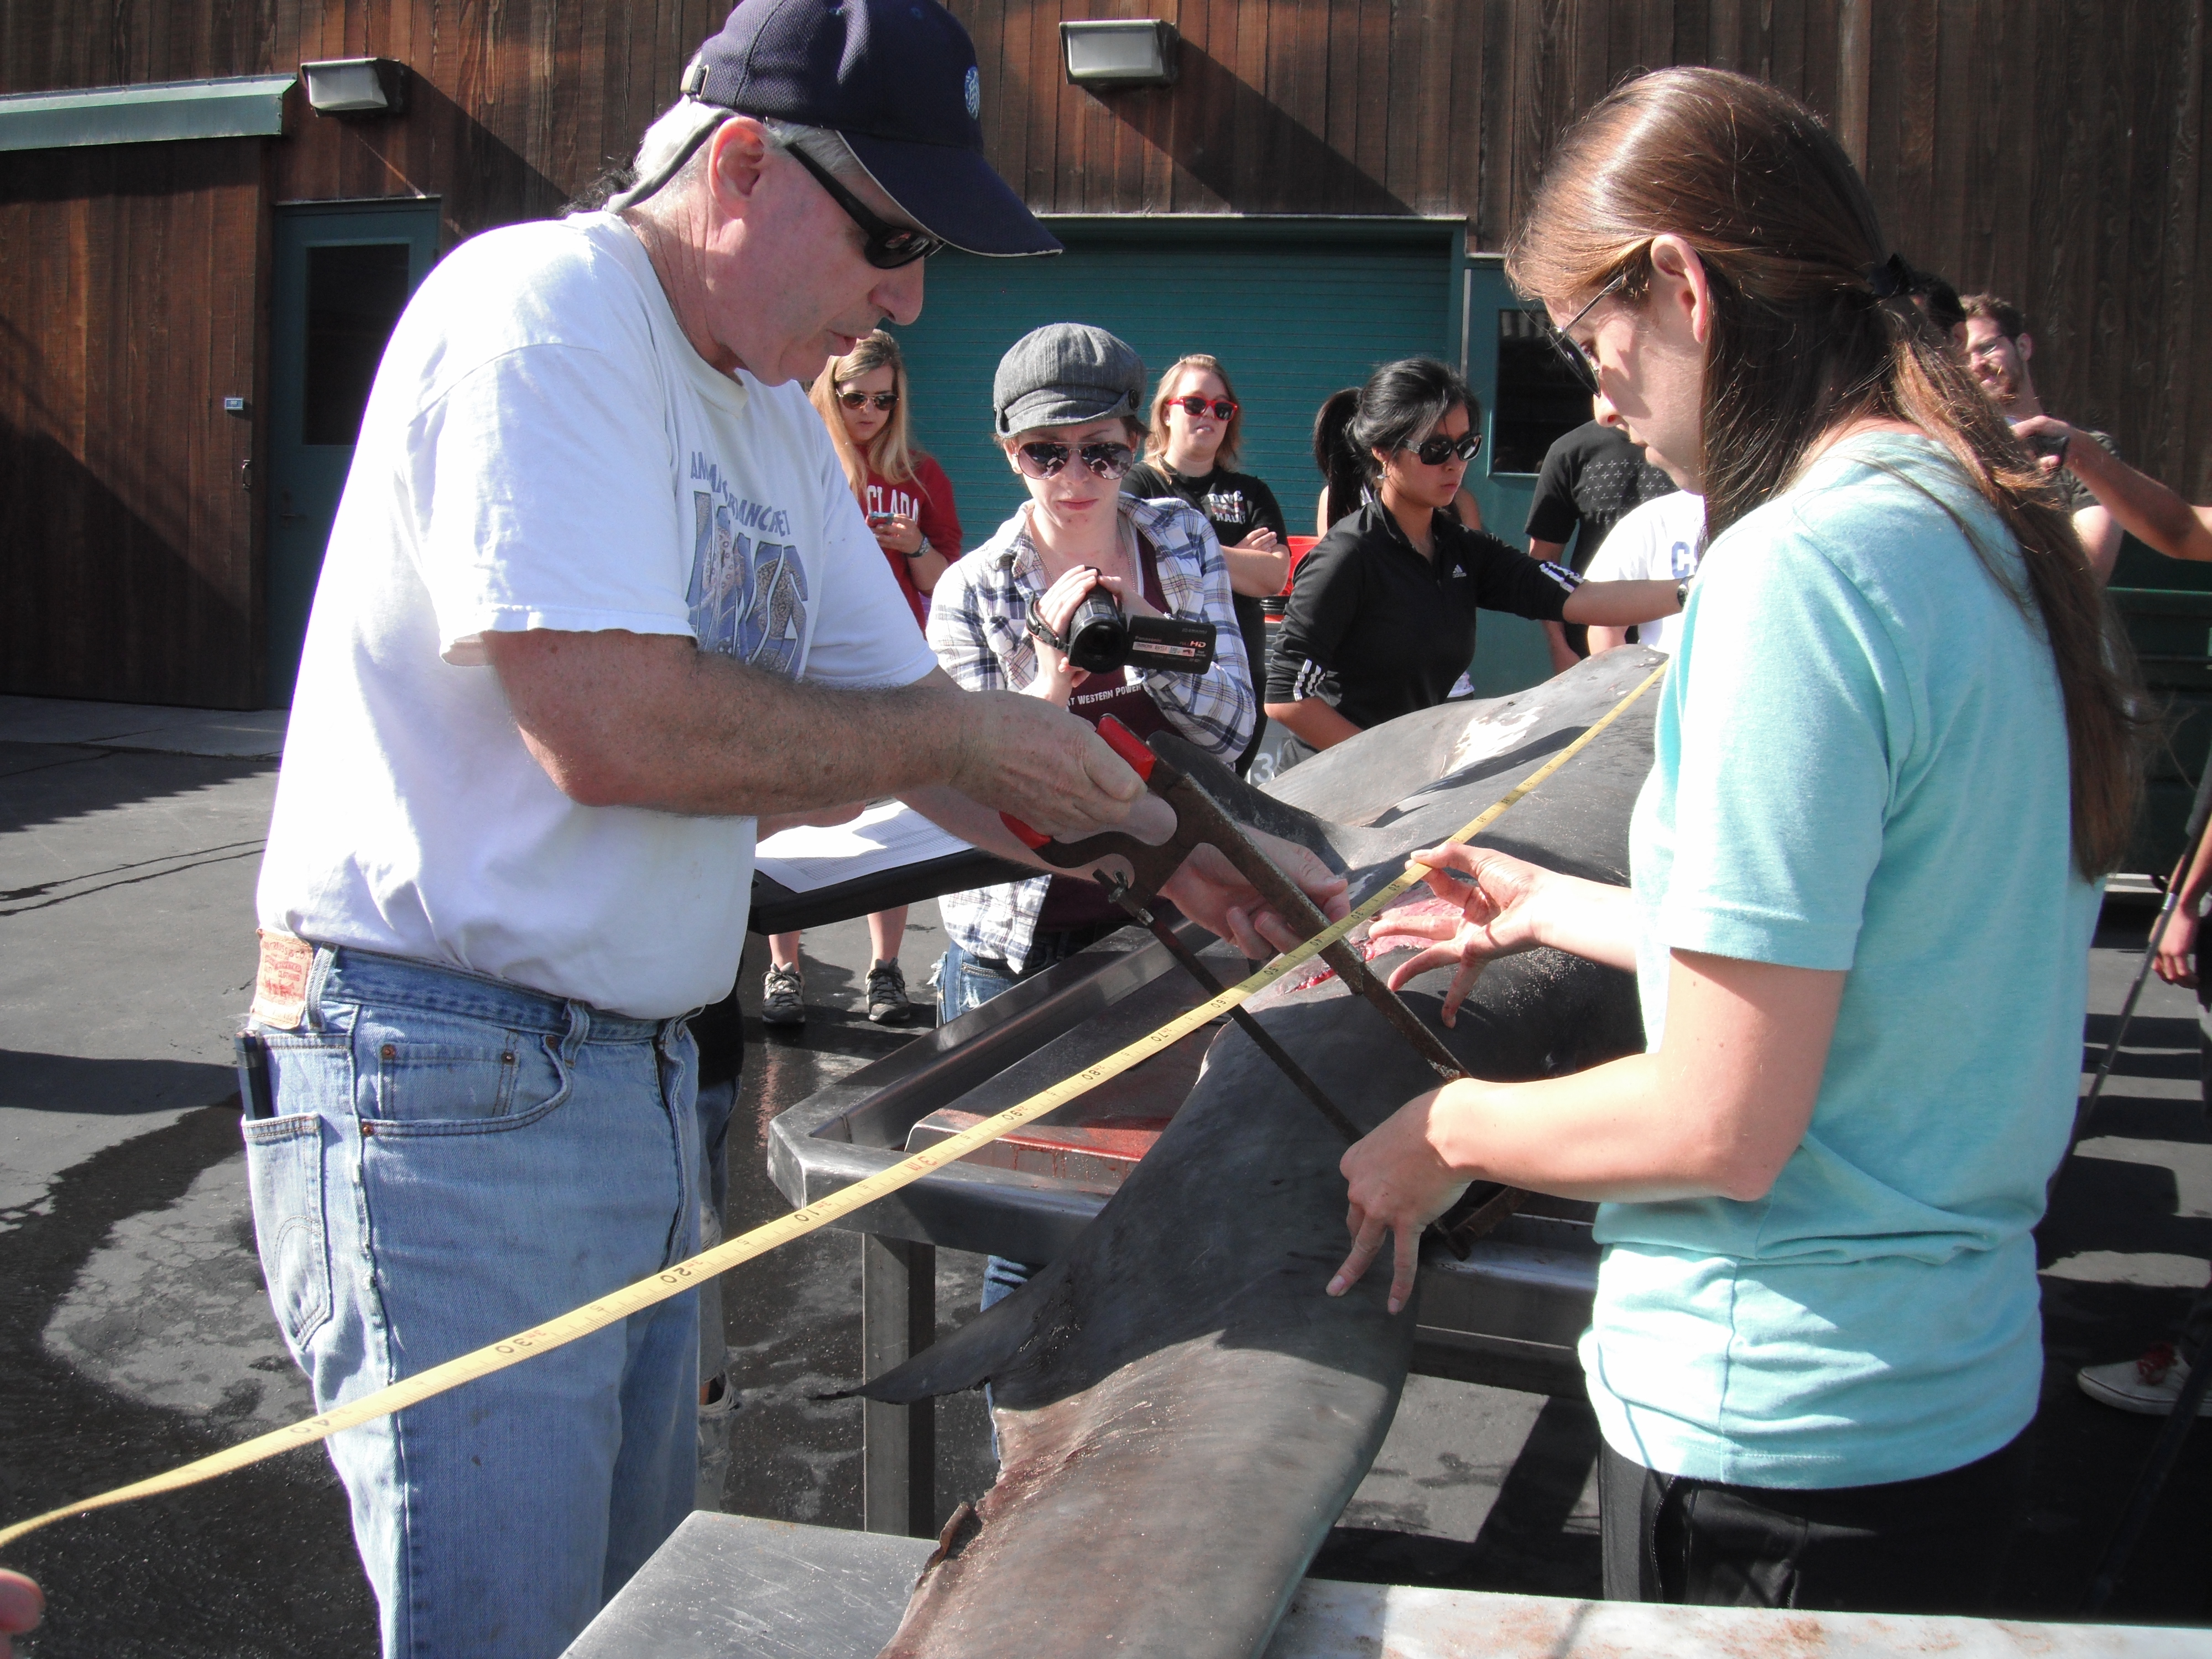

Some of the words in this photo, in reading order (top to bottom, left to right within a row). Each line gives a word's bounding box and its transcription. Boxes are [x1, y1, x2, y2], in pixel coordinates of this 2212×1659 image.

[1077, 689, 1114, 705] WESTERN
[1211, 999, 1227, 1008] 60
[1151, 1032, 1169, 1041] 70
[1081, 1070, 1101, 1080] 80
[1001, 1110, 1023, 1120] 90
[794, 1208, 820, 1222] 10
[660, 1267, 692, 1283] 20
[494, 1338, 533, 1353] 30
[289, 1418, 330, 1434] 40
